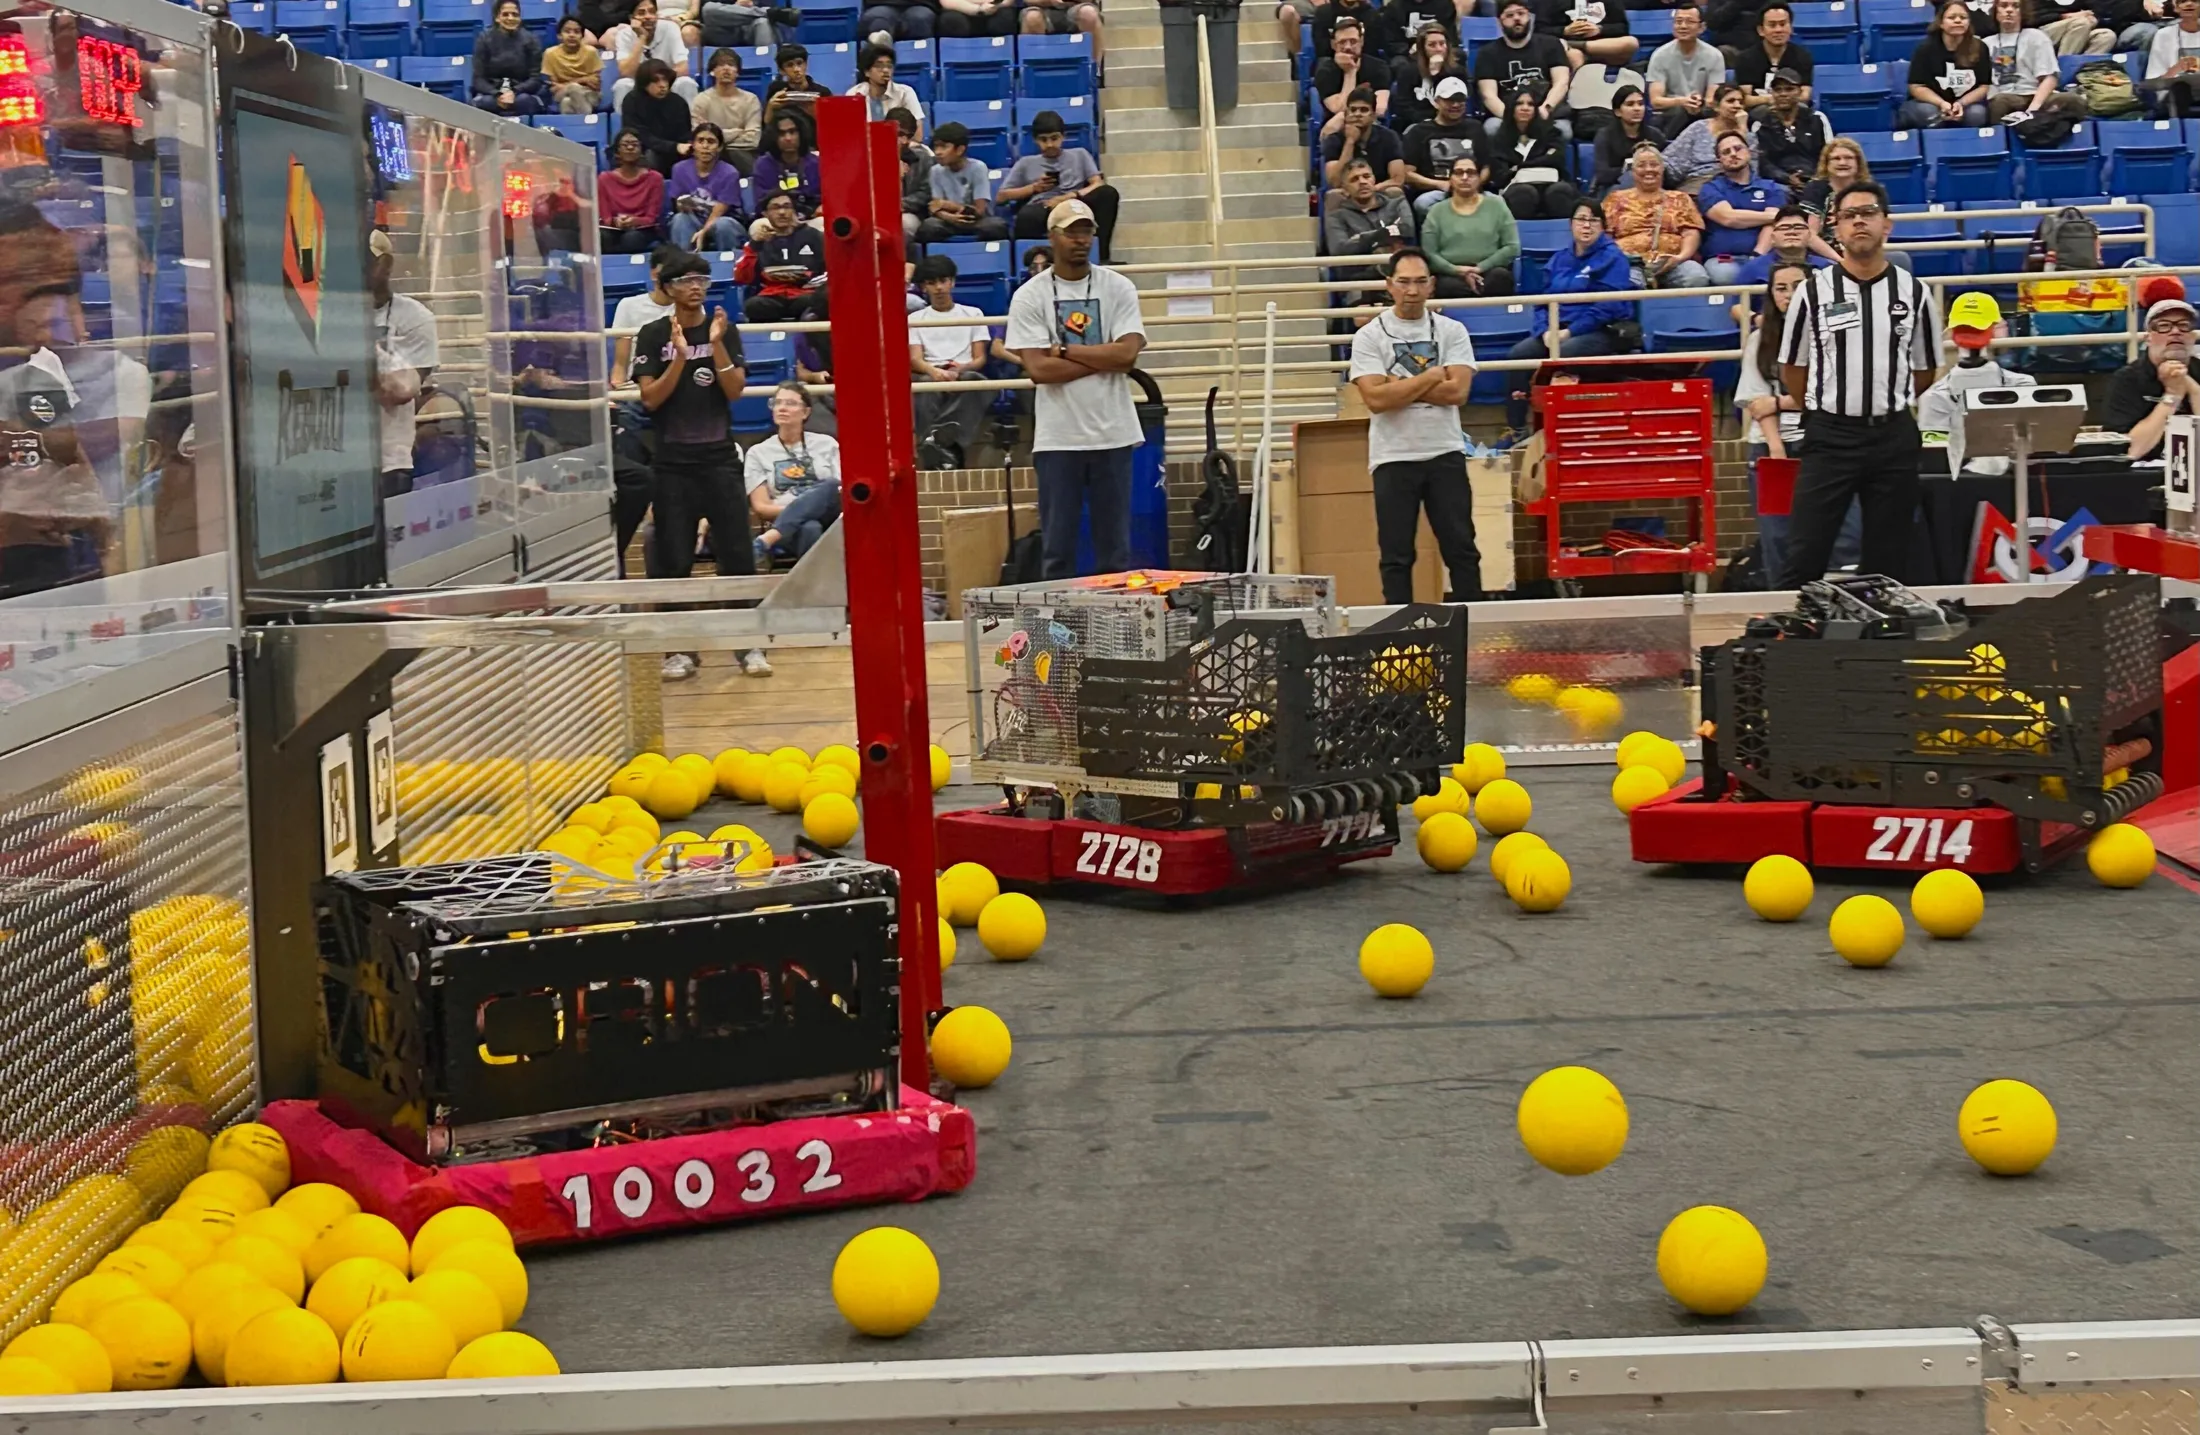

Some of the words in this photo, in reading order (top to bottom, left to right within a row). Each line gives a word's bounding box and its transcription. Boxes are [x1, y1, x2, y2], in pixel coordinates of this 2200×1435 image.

[1077, 832, 1162, 882] 2728
[1866, 816, 1973, 863] 2714
[476, 954, 862, 1066] ORION
[562, 1139, 842, 1229] 10032
